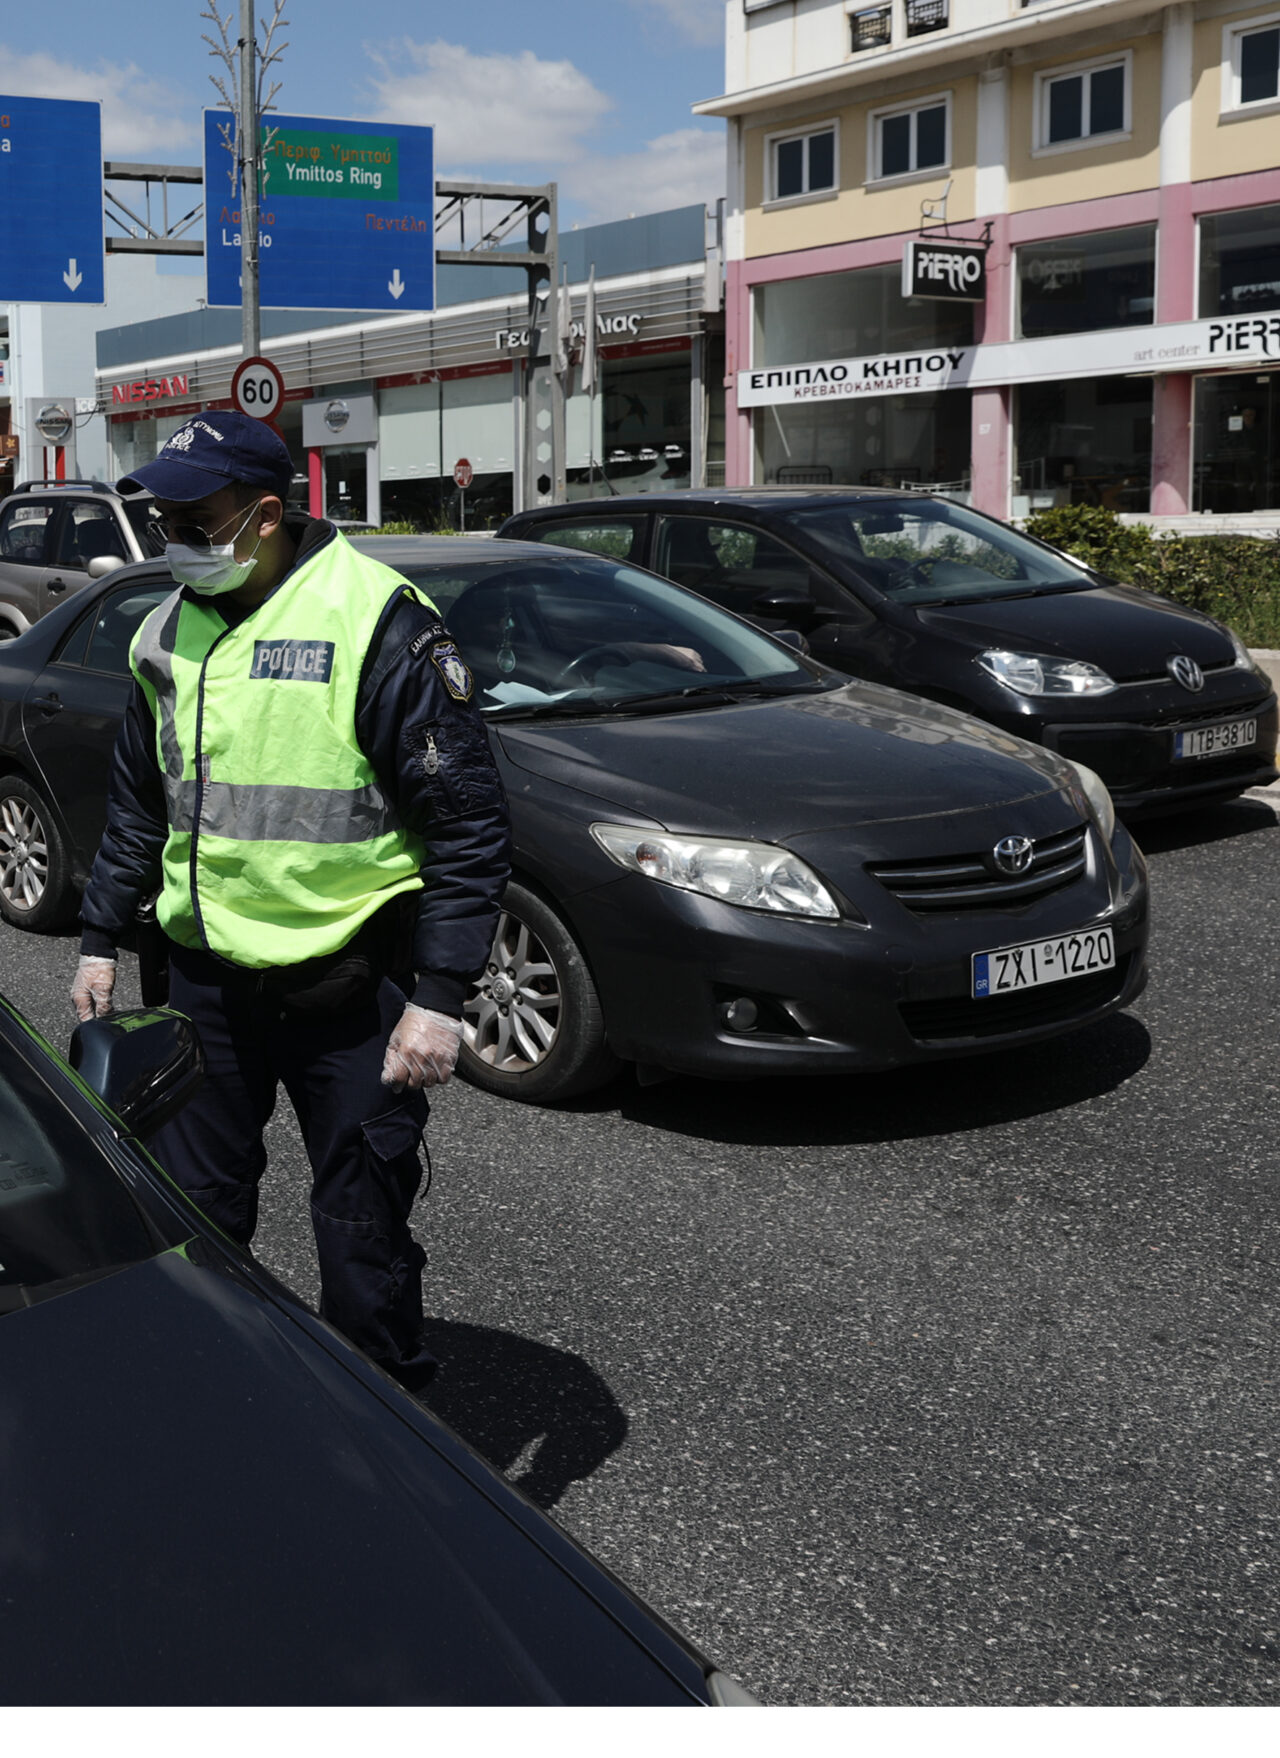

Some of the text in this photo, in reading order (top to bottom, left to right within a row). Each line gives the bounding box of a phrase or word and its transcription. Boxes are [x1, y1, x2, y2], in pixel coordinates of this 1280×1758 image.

[331, 144, 391, 165] Υμηττού
[286, 163, 382, 189] Ymittos Ring
[219, 207, 275, 225] Λαιο
[365, 213, 426, 232] Πεντέλη
[222, 229, 272, 248] Laio
[1134, 343, 1200, 361] art center
[751, 352, 965, 390] ΕΠΙΠΛΟ ΚΗΠΟΥ
[112, 374, 189, 405] NISSAN
[243, 378, 274, 405] 60
[794, 376, 922, 398] ΚΡΕΒΑΤΟΚΑΜΑΡΕΣ
[256, 647, 329, 675] POLICE
[976, 979, 988, 989] GR
